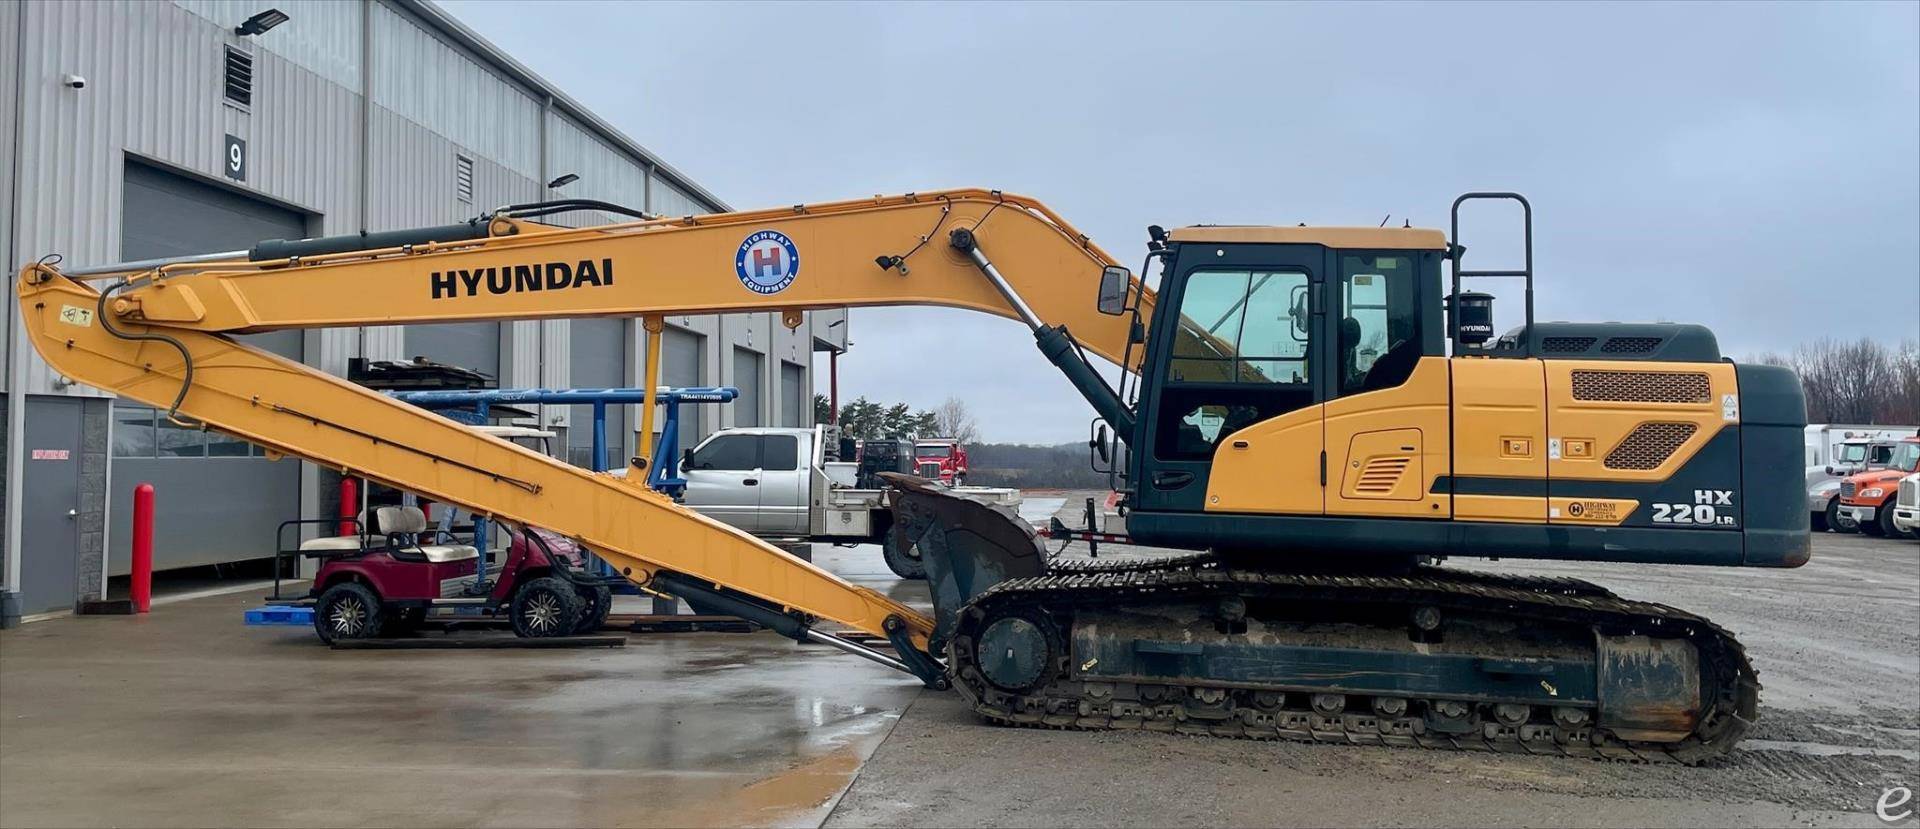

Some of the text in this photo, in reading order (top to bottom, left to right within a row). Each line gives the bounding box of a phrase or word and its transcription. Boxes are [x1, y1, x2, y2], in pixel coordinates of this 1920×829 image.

[230, 143, 242, 172] 9
[742, 232, 791, 251] HIGHWAY
[753, 247, 781, 277] H
[431, 258, 613, 299] HYUNDAI
[742, 272, 794, 293] EQUIPMENT
[1694, 490, 1733, 505] HX
